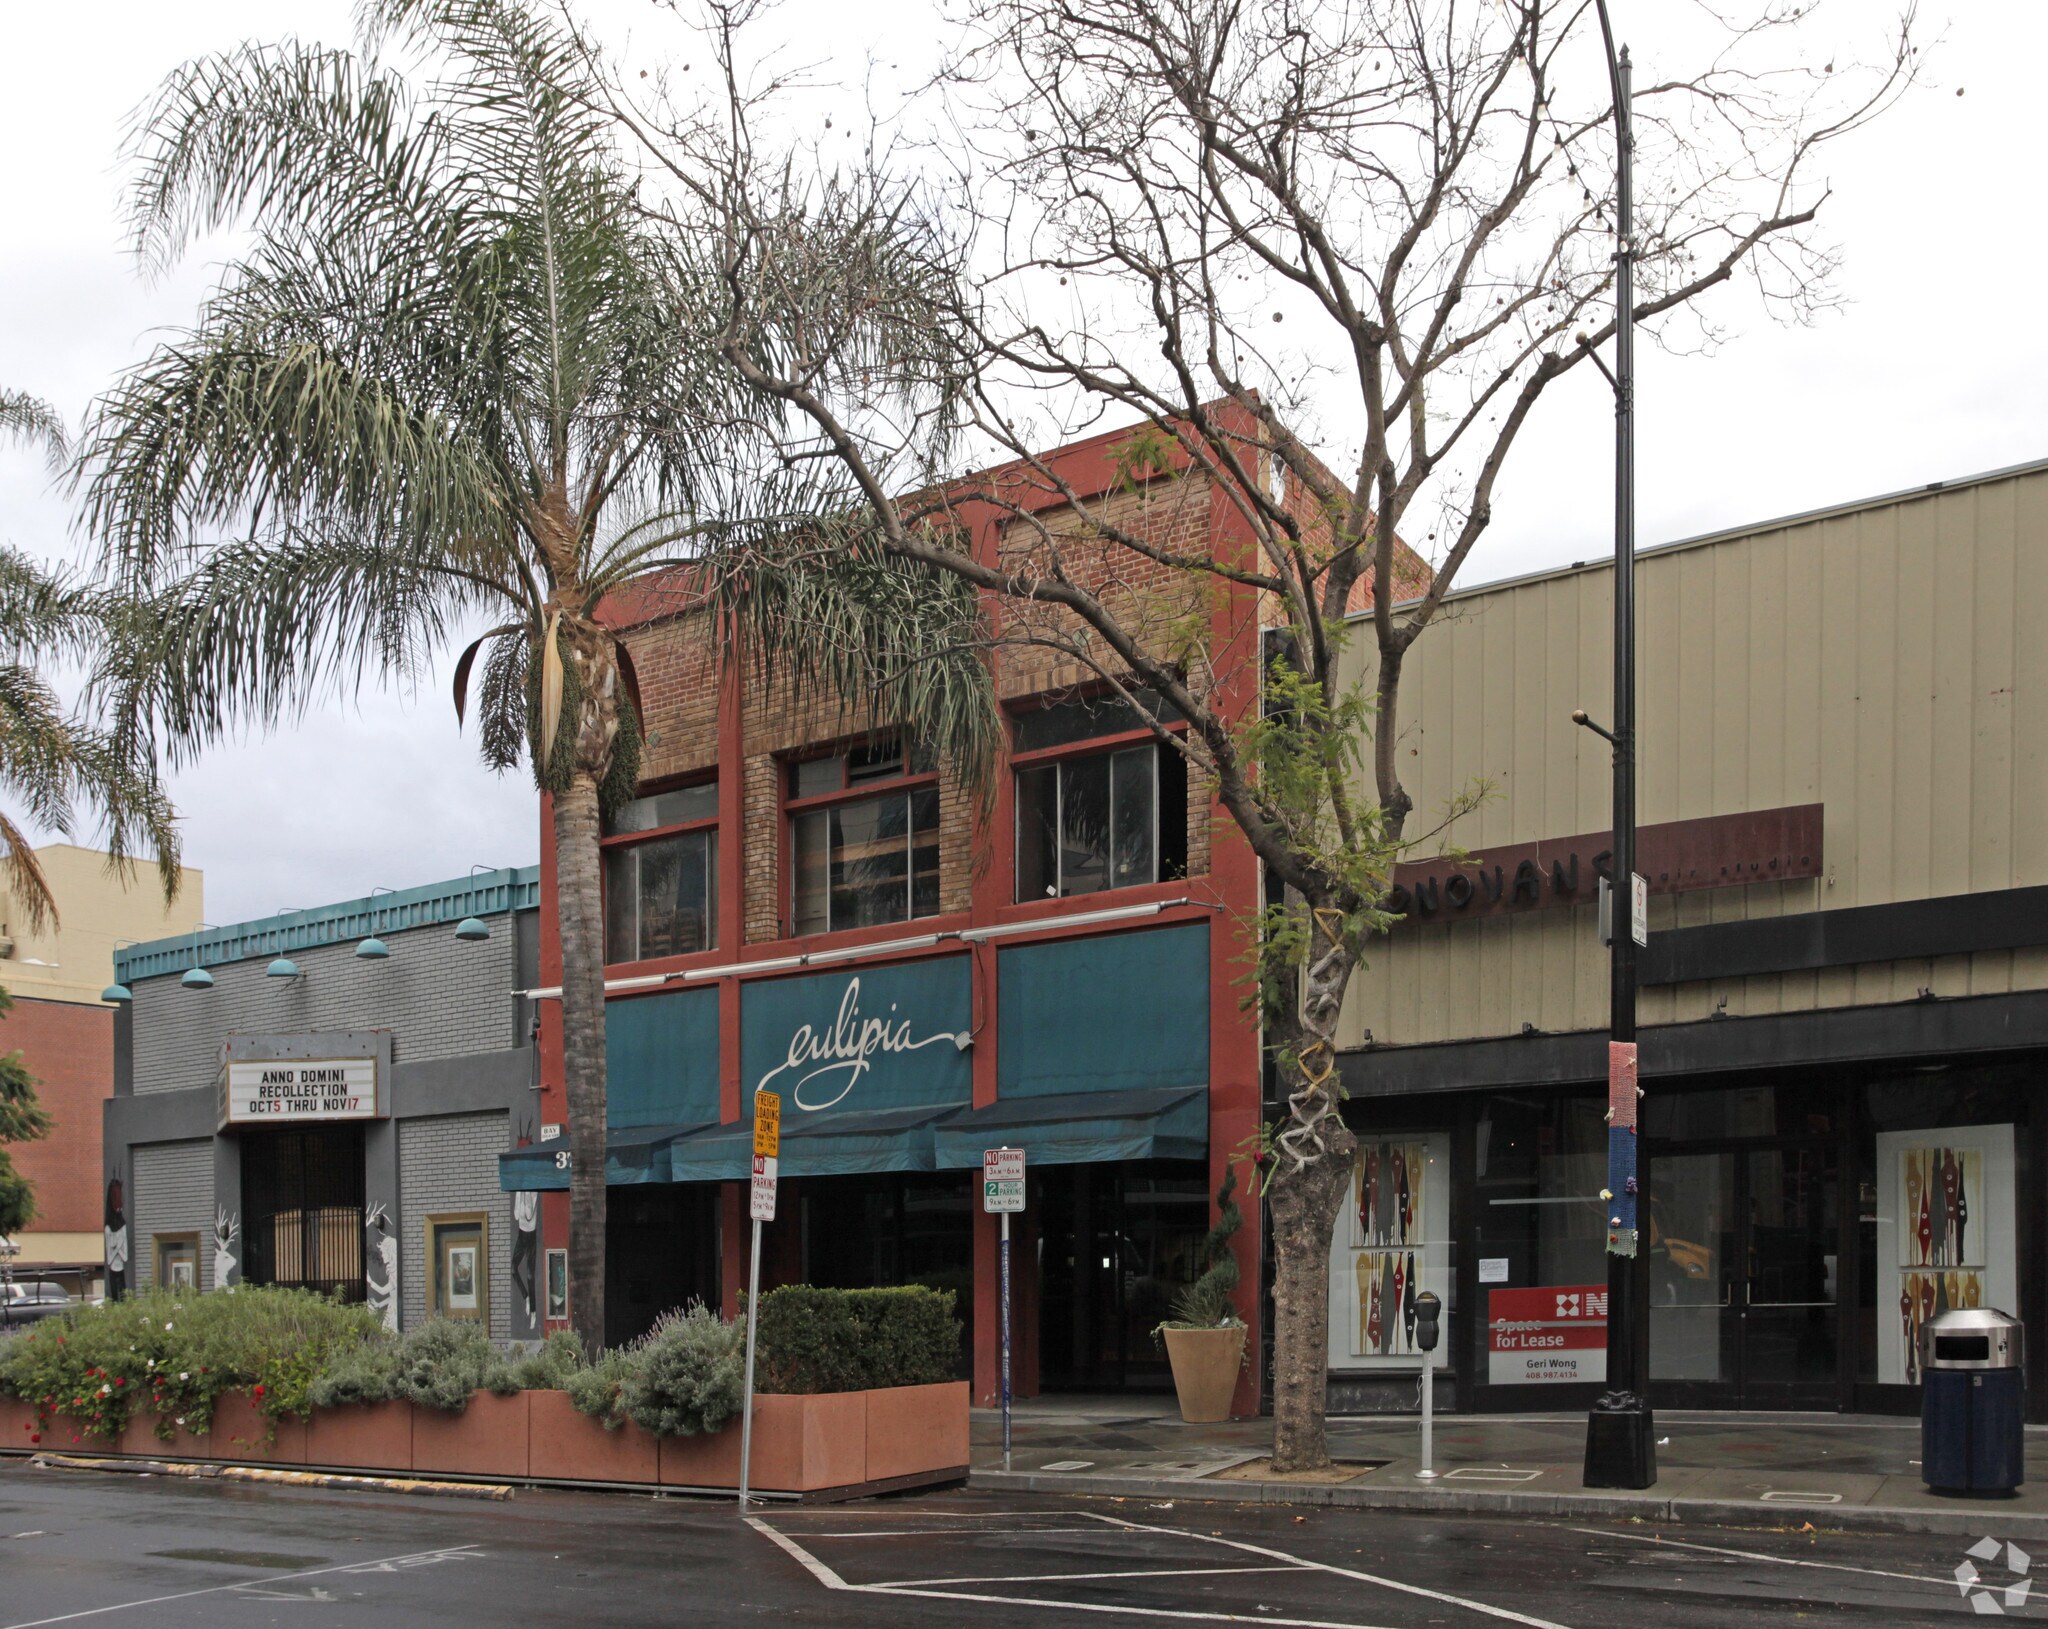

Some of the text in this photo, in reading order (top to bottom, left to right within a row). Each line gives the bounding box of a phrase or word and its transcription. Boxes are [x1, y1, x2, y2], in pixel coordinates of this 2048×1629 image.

[1721, 855, 1810, 876] studio
[1384, 851, 1612, 915] ONOVANS
[757, 976, 956, 1111] eulipia
[261, 1069, 345, 1084] ANNO DOMINI
[259, 1084, 348, 1098] RECOLLECTION
[250, 1098, 359, 1113] OCT5 THRU NOV17
[757, 1093, 779, 1108] FREIGHT
[756, 1106, 779, 1121] LOADING
[760, 1119, 774, 1133] ZONE
[754, 1157, 764, 1172] NO
[986, 1151, 1022, 1164] NO PARKING
[753, 1176, 776, 1190] PARKING
[989, 1183, 997, 1195] 2
[1000, 1187, 1022, 1196] PARKING
[1496, 1333, 1564, 1348] for Lease
[1526, 1359, 1577, 1369] Geri Wong
[1525, 1371, 1578, 1379] 408.987.4134
